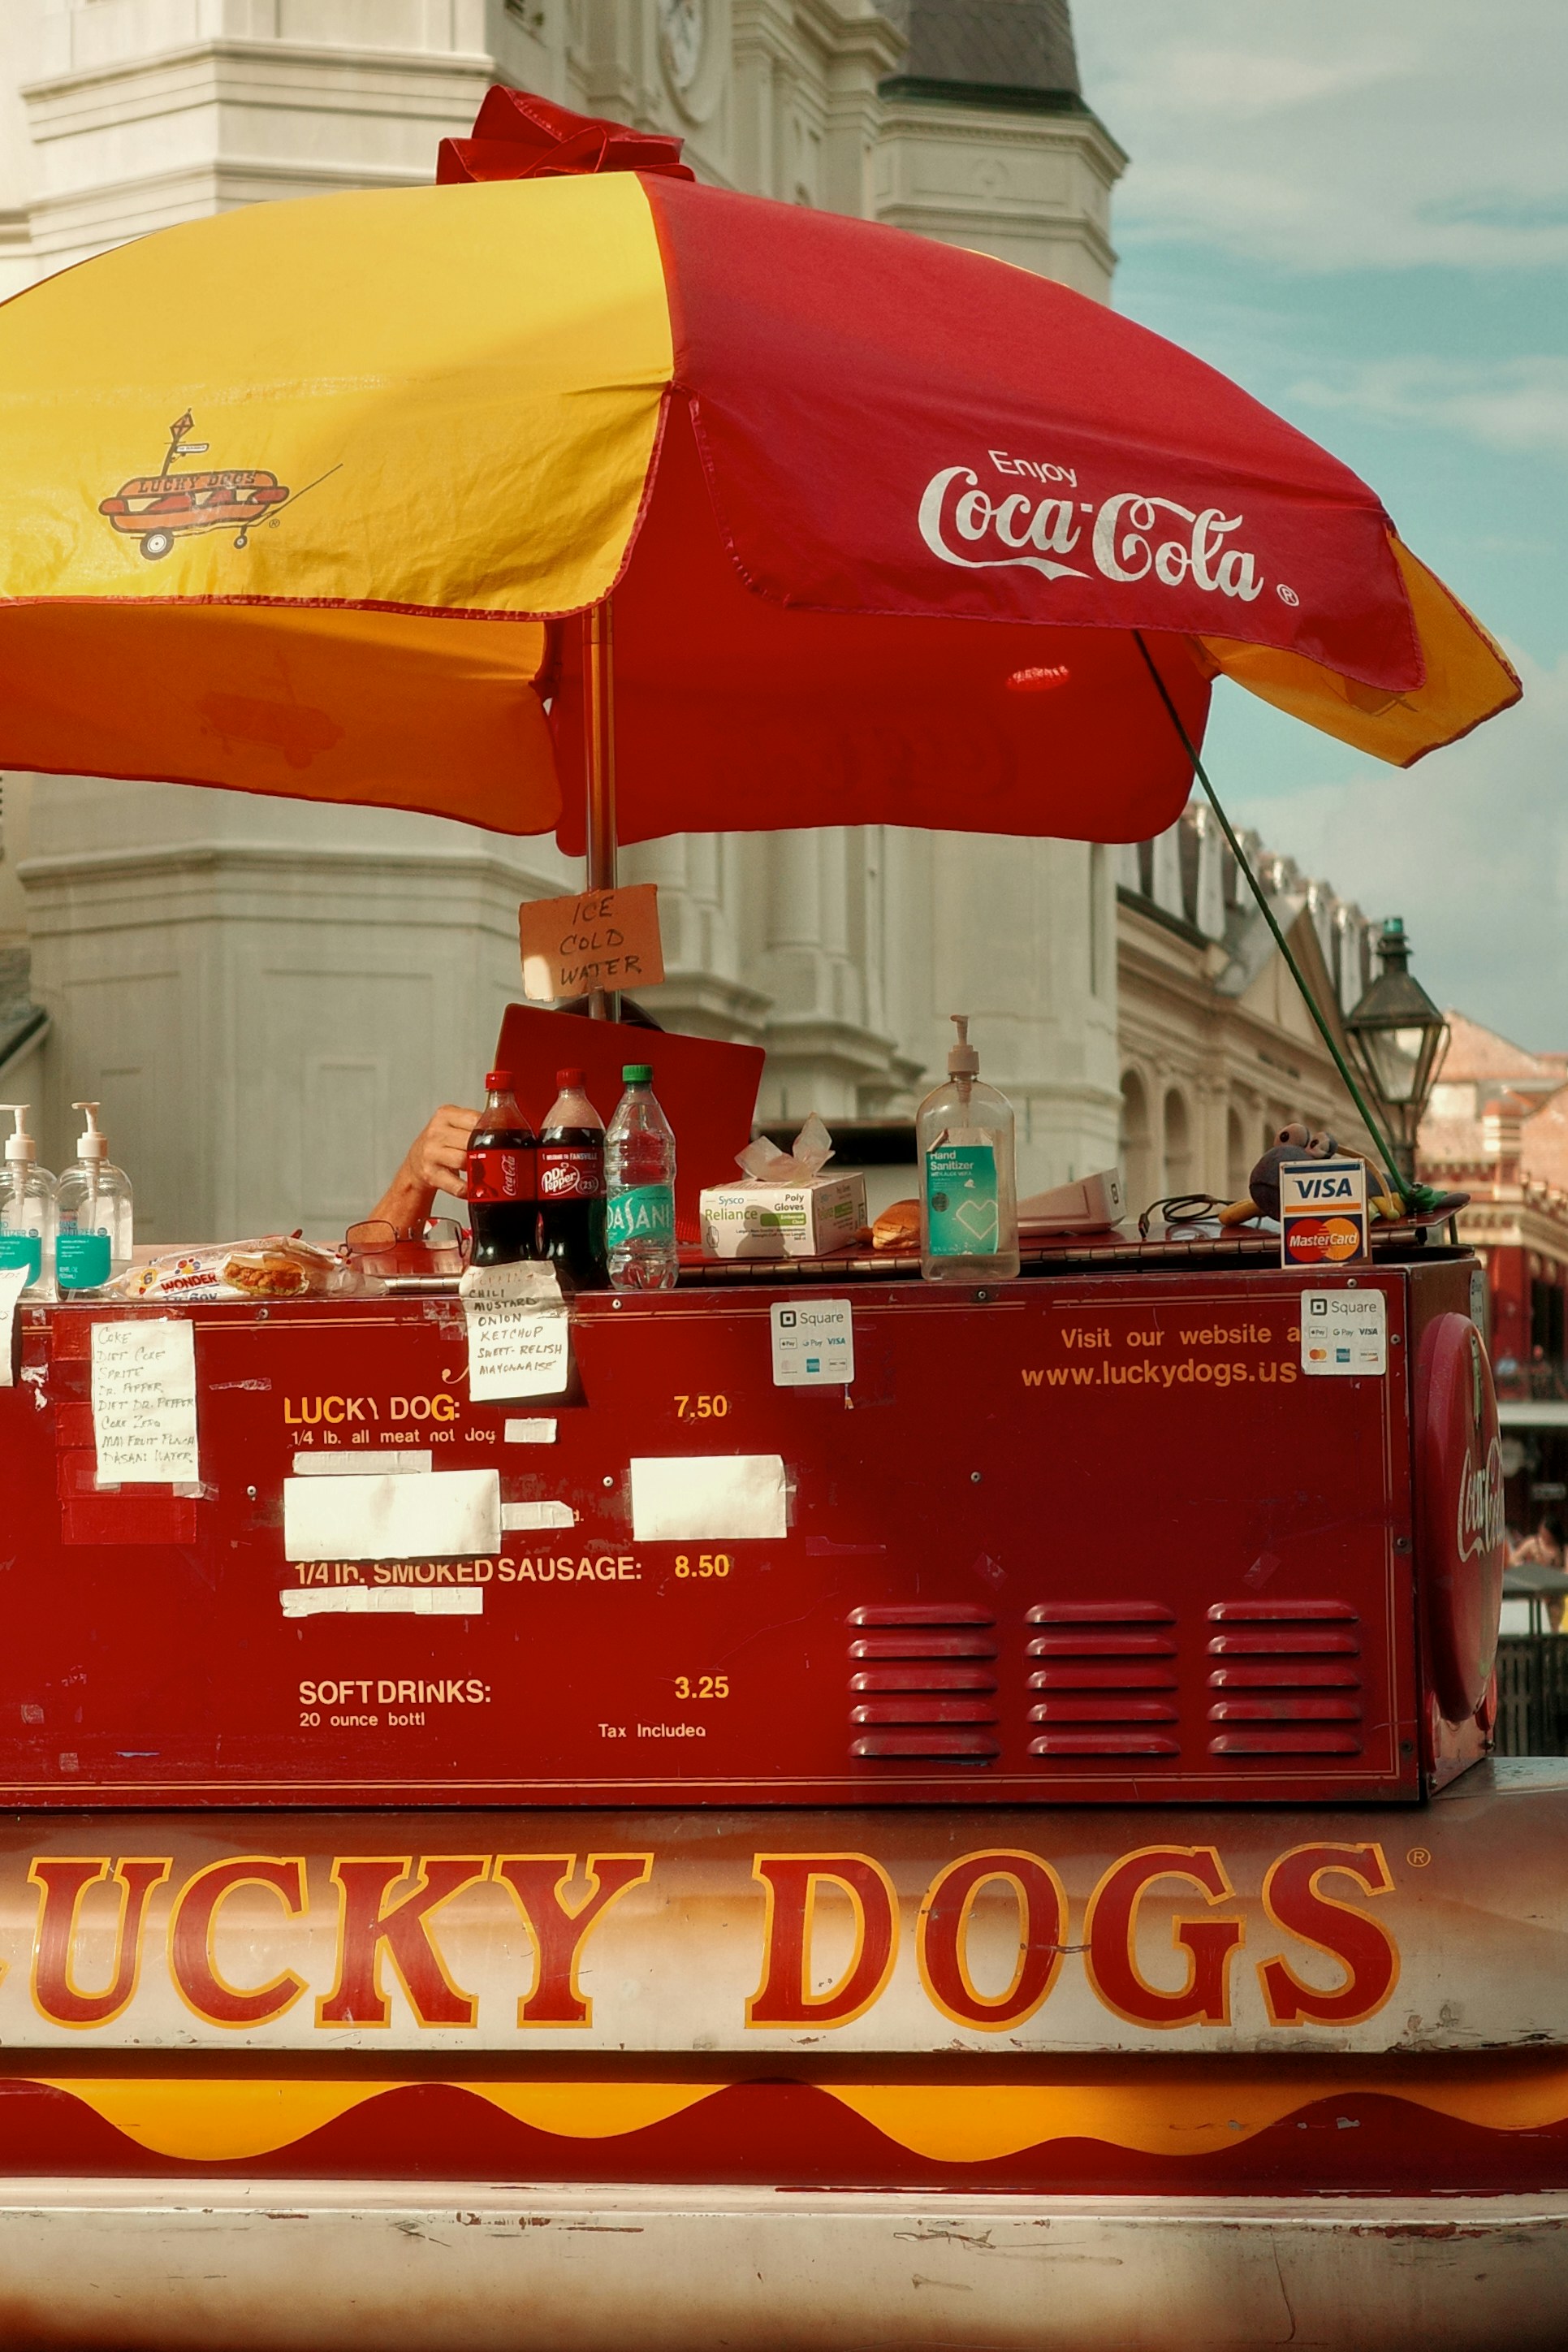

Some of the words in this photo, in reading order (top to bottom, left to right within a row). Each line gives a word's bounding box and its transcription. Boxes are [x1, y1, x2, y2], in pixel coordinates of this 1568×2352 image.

[987, 449, 1078, 487] Enjoy
[137, 477, 200, 493] LUCKY
[206, 472, 257, 486] DOGS
[918, 465, 1264, 602] Coca-Cola
[572, 895, 616, 926] ICE
[559, 928, 624, 956] COLD
[560, 955, 642, 986] WATER
[930, 1150, 957, 1161] Hand
[930, 1160, 974, 1171] Sanitizer
[542, 1170, 577, 1194] Pepper
[1293, 1177, 1353, 1200] VISA
[718, 1195, 745, 1207] Sysco
[784, 1193, 805, 1204] Poly
[705, 1208, 758, 1221] Reliance
[774, 1203, 805, 1212] Gloves
[607, 1197, 671, 1237] DASANI
[1289, 1232, 1359, 1247] MasterCard
[160, 1273, 218, 1293] WONDER
[469, 1288, 505, 1299] CHILI
[473, 1297, 538, 1312] MUSTARD
[1331, 1300, 1377, 1316] Square
[477, 1312, 522, 1327] ONION
[800, 1312, 844, 1327] Square
[480, 1325, 544, 1342] KETCHUP
[1060, 1327, 1112, 1349] Visit
[1125, 1330, 1165, 1347] our
[1179, 1323, 1273, 1346] website
[1286, 1327, 1301, 1342] a
[1359, 1327, 1378, 1336] VISA
[520, 1344, 563, 1355] RELISH
[827, 1337, 846, 1346] VISA
[479, 1360, 557, 1376] MAYONNAISE
[1022, 1357, 1298, 1388] www.luckydogs.us
[98, 1399, 128, 1412] DIET
[390, 1393, 460, 1422] DOG:
[673, 1394, 728, 1418] 7.50
[291, 1429, 314, 1446] 1/4
[323, 1429, 342, 1445] lb.
[351, 1429, 370, 1444] all
[379, 1429, 421, 1444] meat
[294, 1561, 329, 1585] 1/4
[373, 1559, 494, 1584] SMOKED
[498, 1555, 642, 1582] SAUSAGE:
[674, 1554, 731, 1578] 8.50
[298, 1680, 374, 1705] SOFT
[377, 1679, 491, 1704] DRINKS:
[675, 1675, 730, 1700] 3.25
[299, 1711, 321, 1727] 20
[330, 1714, 378, 1727] ounce
[598, 1723, 627, 1738] Tax
[0, 1851, 656, 2030] UCKY
[743, 1842, 1402, 2033] DOGS
